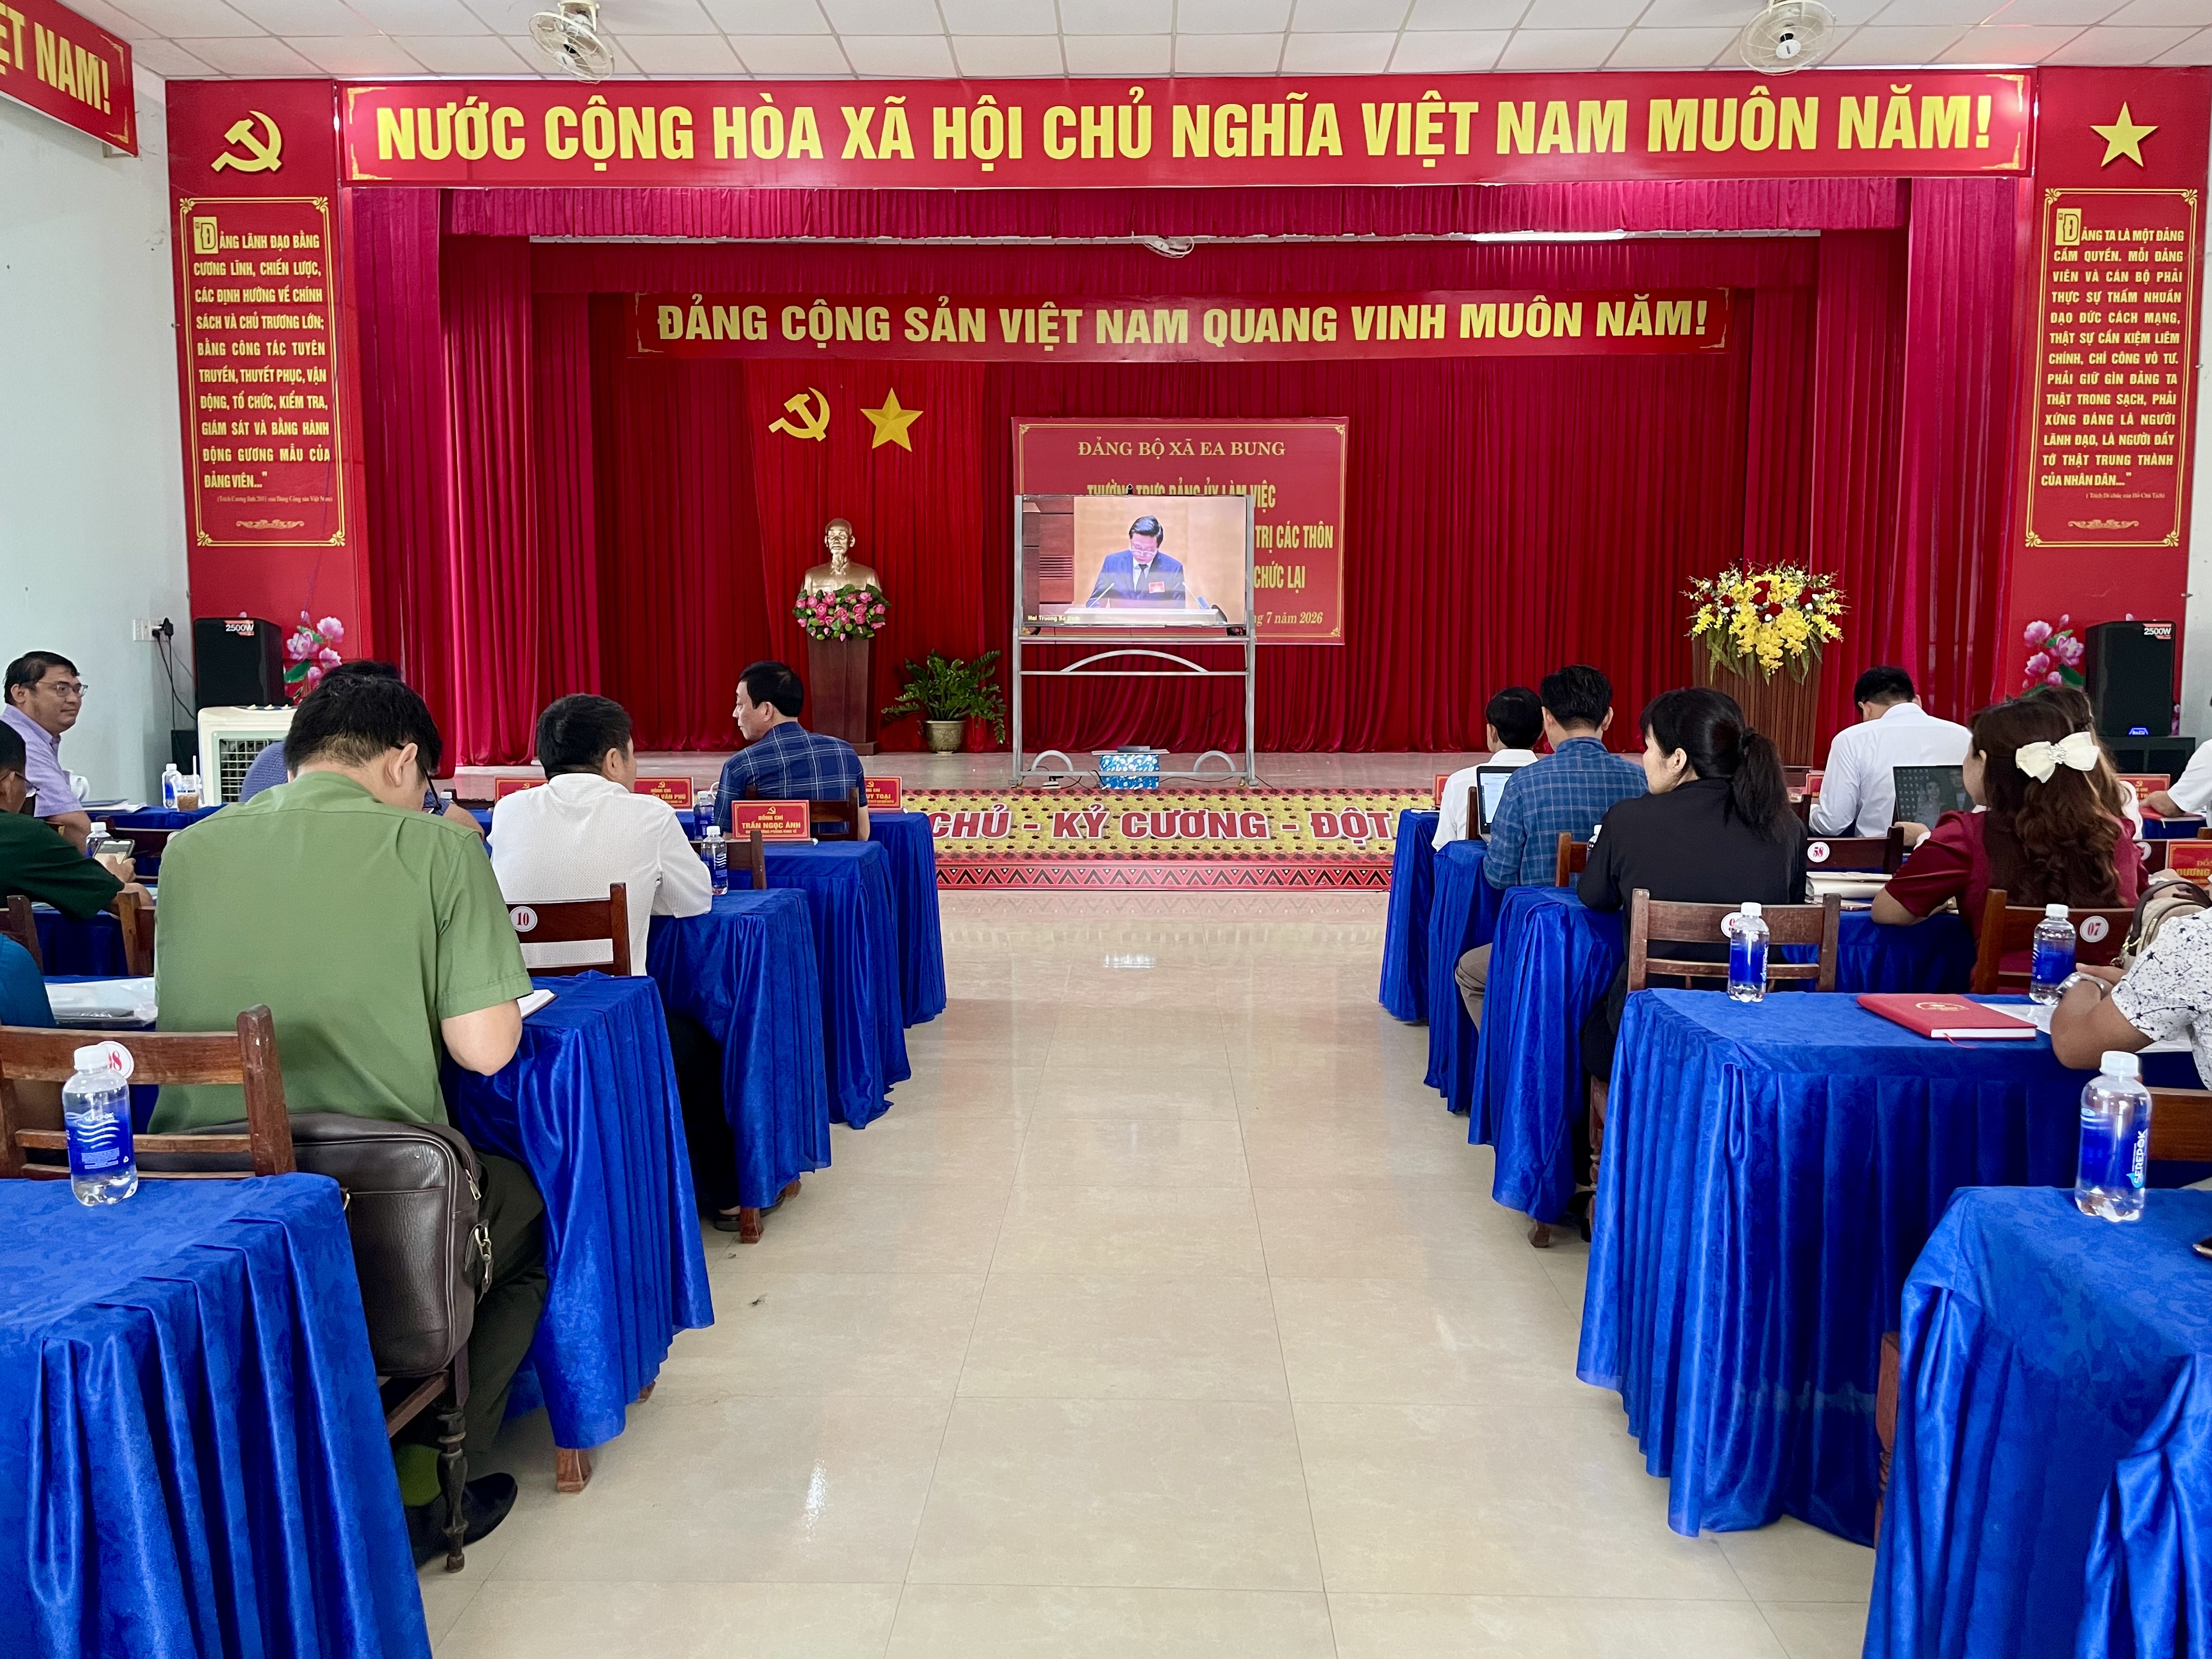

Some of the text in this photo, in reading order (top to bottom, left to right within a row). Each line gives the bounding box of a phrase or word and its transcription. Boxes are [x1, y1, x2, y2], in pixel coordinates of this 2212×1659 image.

[35, 21, 110, 115] NAM!
[377, 84, 1991, 172] NƯỚC CỘNG HÒA XÃ HỘI CHỦ NGHĨA VIỆT NAM MUÔN NĂM!
[658, 293, 1708, 351] ĐẢNG CỘNG SẢN VIỆT NAM QUANG VINH MUÔN NĂM!
[1077, 437, 1285, 459] ĐẢNG BỘ XÃ EA BUNG
[1250, 479, 1276, 513] VIỆC
[1255, 521, 1333, 553] TRỊ CÁC THÔN
[1254, 561, 1305, 593] CHỨC LẠI
[1266, 612, 1273, 623] 7
[1274, 612, 1297, 623] năm
[1299, 612, 1323, 624] 2026
[928, 804, 1391, 844] CHỦ KỶ CƯƠNG ĐỘT
[1813, 847, 1824, 857] 58
[517, 912, 529, 926] 10
[2087, 923, 2102, 936] 07
[2134, 1128, 2147, 1184] SEREPOK
